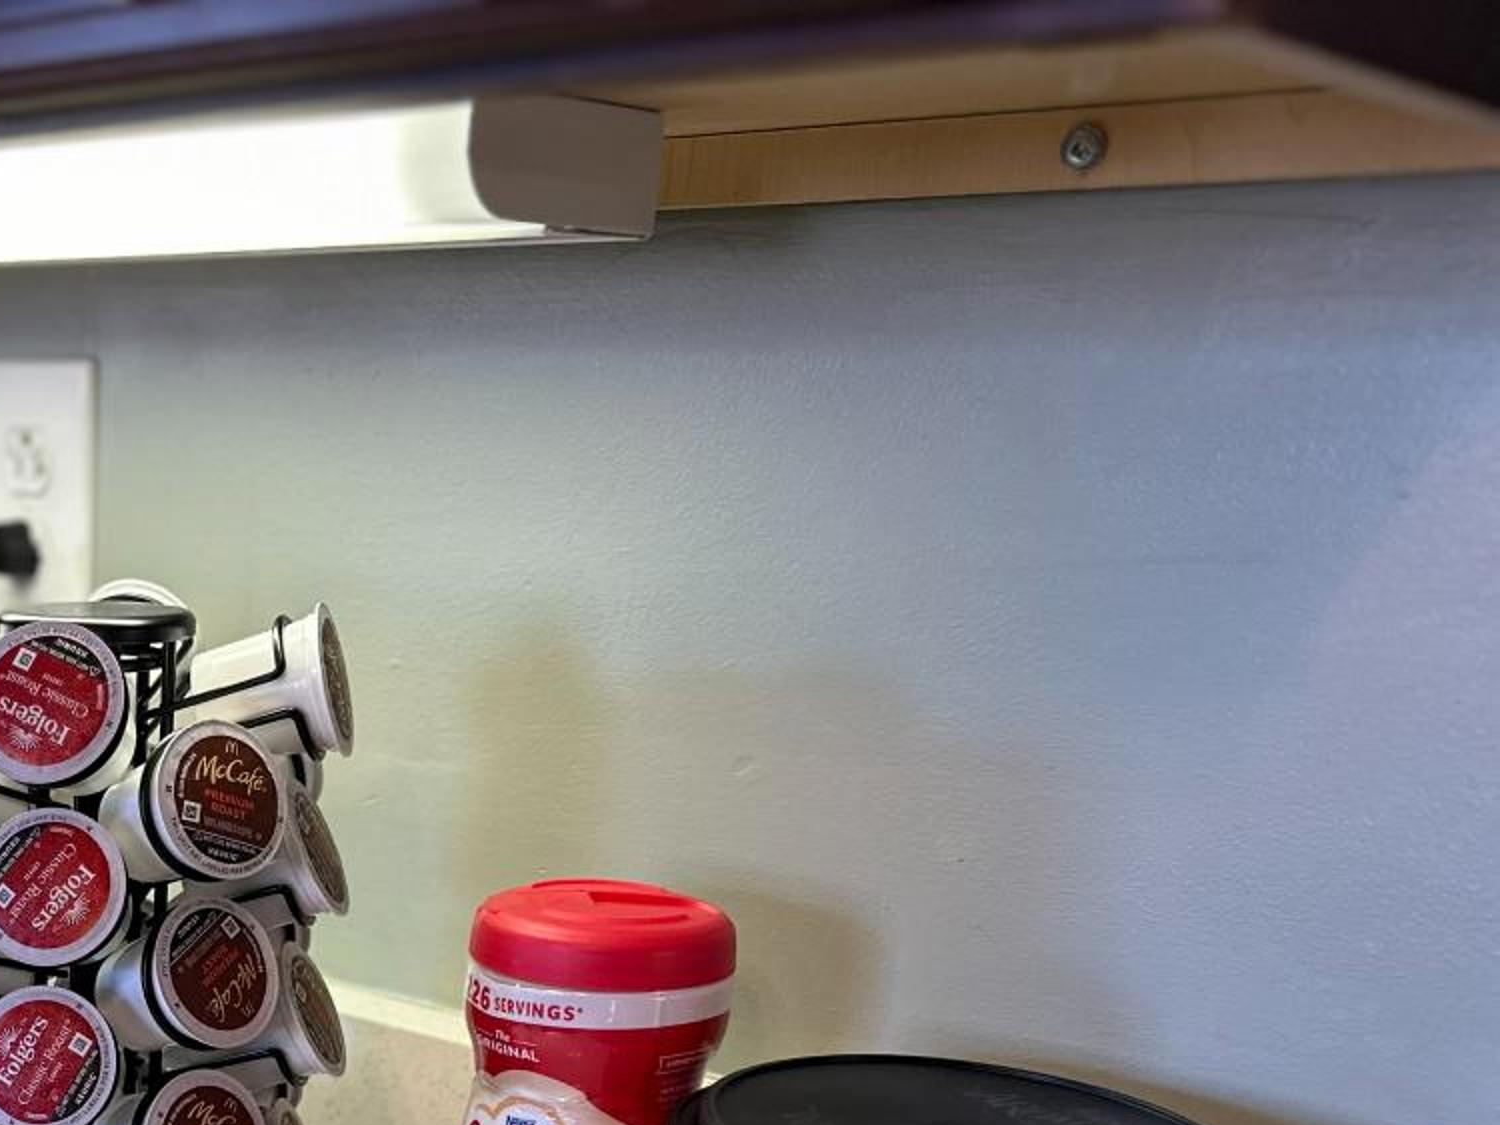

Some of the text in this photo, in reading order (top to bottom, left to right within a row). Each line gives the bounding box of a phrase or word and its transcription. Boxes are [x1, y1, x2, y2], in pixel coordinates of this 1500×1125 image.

[4, 669, 42, 695] Roast
[43, 687, 89, 718] Classic
[195, 755, 266, 796] McCafé
[211, 802, 247, 820] ROAST
[37, 843, 77, 885] Classic
[12, 883, 43, 920] Roast
[31, 864, 97, 931] Folgers
[209, 953, 257, 1023] McCafé
[17, 1061, 49, 1105] Classic
[44, 1025, 72, 1060] Roast
